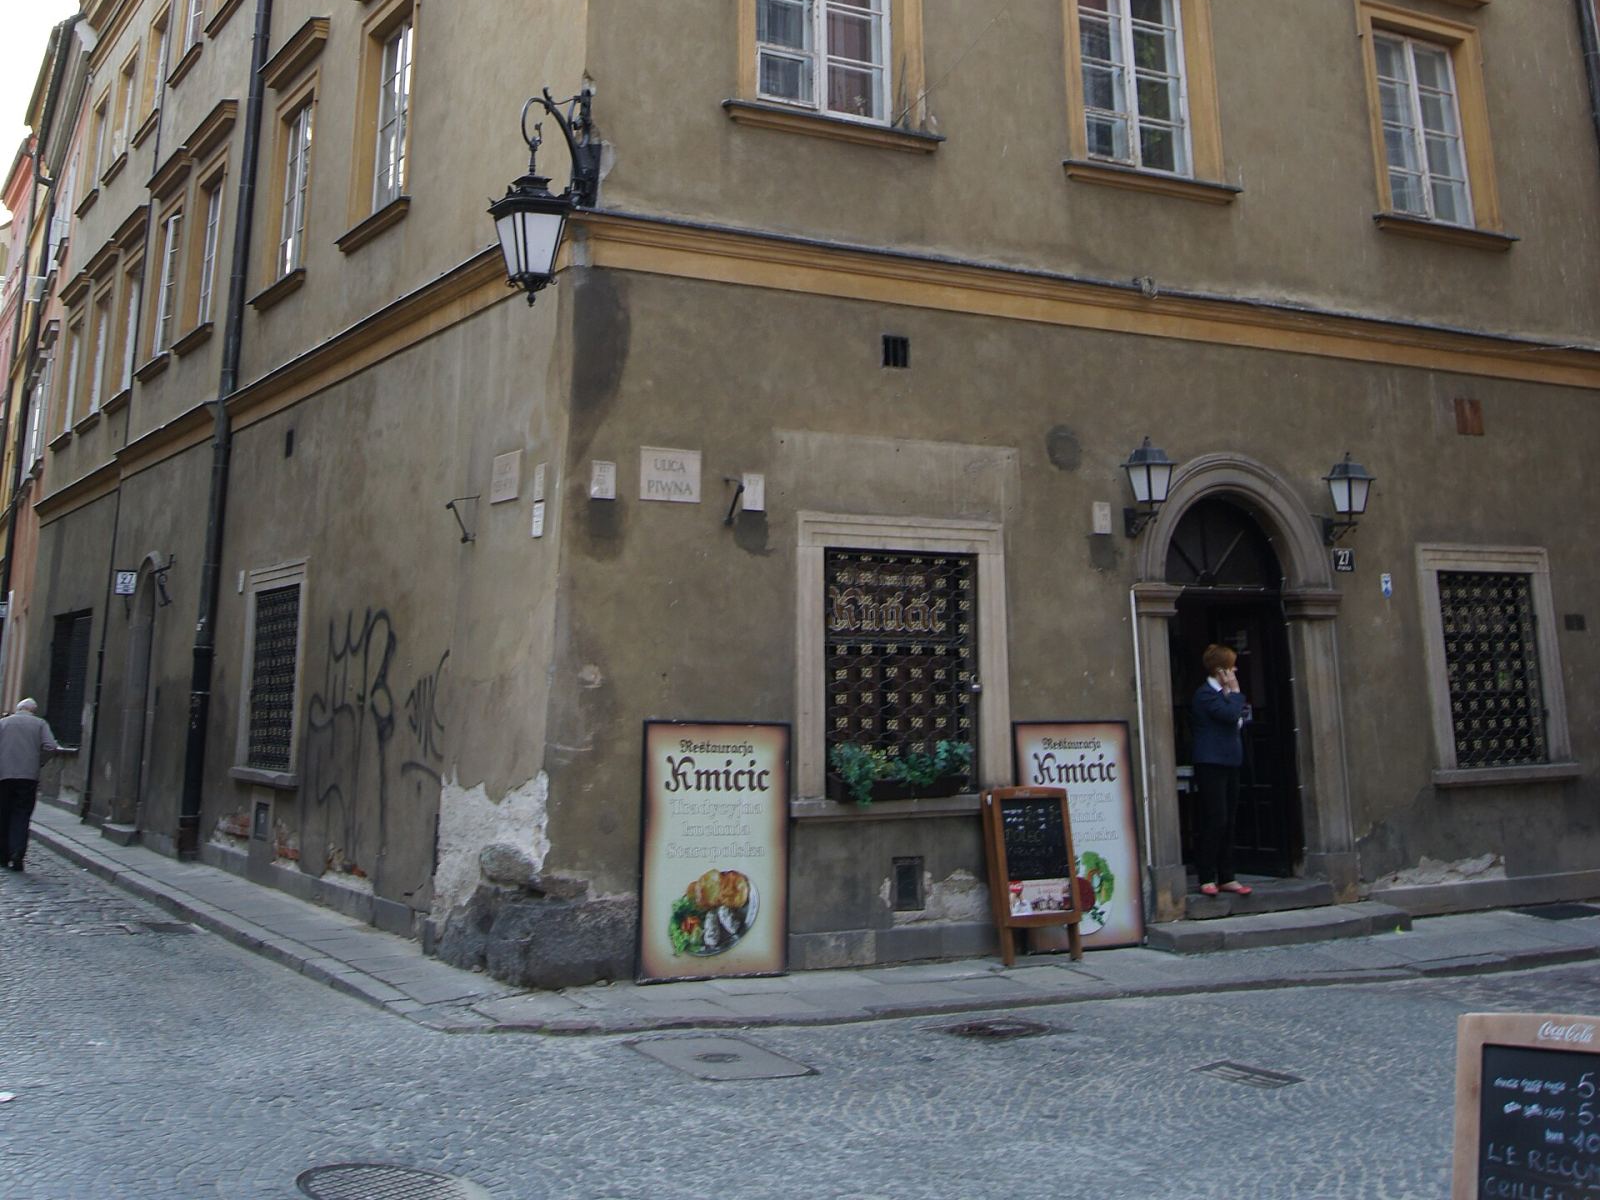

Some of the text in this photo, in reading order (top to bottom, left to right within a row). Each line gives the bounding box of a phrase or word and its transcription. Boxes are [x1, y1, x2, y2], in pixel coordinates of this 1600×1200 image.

[654, 458, 686, 473] ULICA
[647, 480, 693, 497] PIWNA
[1337, 550, 1350, 565] 27
[120, 573, 134, 585] 27
[679, 739, 754, 757] Restauracja
[664, 755, 770, 792] Kmicic
[1033, 753, 1117, 786] Kmicic
